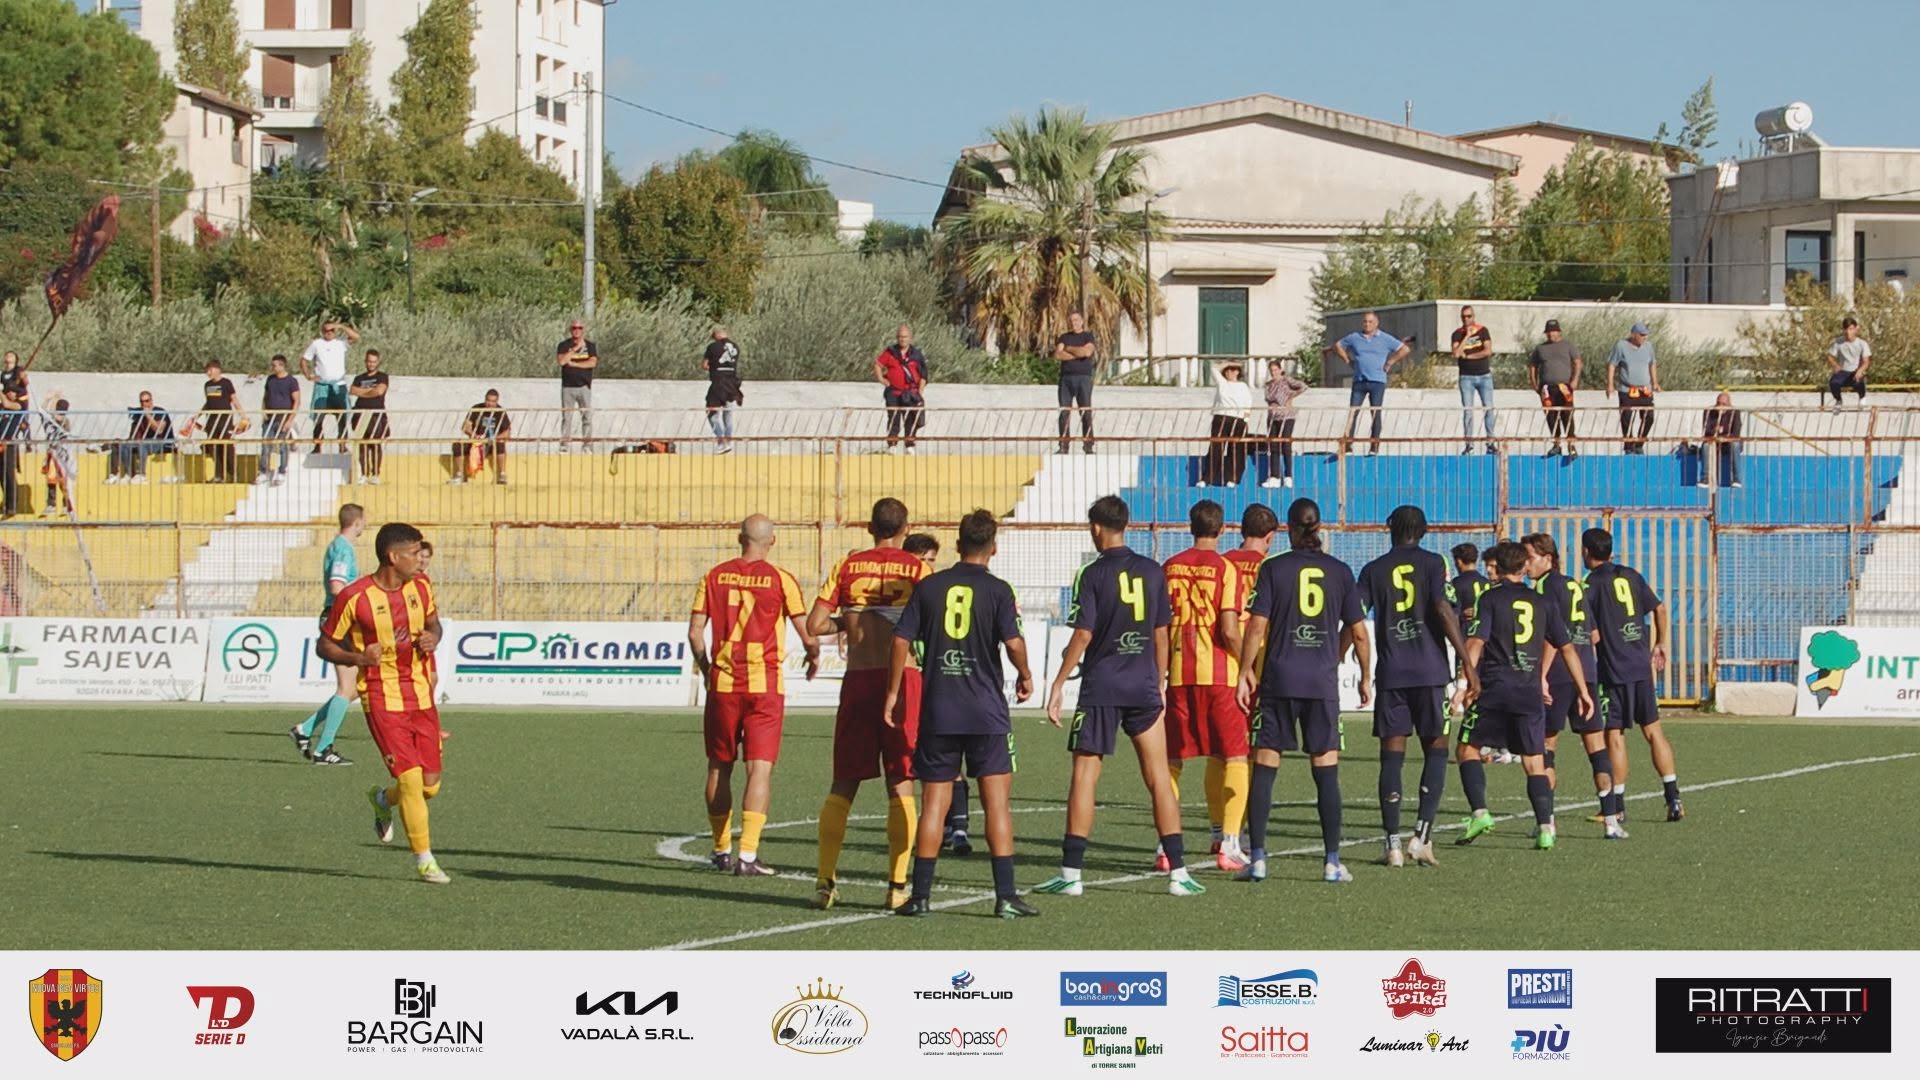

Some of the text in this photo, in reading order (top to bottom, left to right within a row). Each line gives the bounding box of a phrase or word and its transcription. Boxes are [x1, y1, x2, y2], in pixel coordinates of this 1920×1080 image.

[1119, 571, 1145, 622] 4
[1299, 567, 1325, 617] 6
[1392, 564, 1415, 612] 5
[1566, 580, 1586, 622] 2
[1613, 577, 1635, 617] 9
[43, 624, 199, 644] FARMACIA
[728, 589, 756, 642] 7
[944, 585, 974, 640] 8
[1512, 600, 1534, 644] 3
[63, 650, 172, 672] SAJEVA
[457, 631, 685, 661] CP RICAMBI
[1867, 655, 1920, 679] INT
